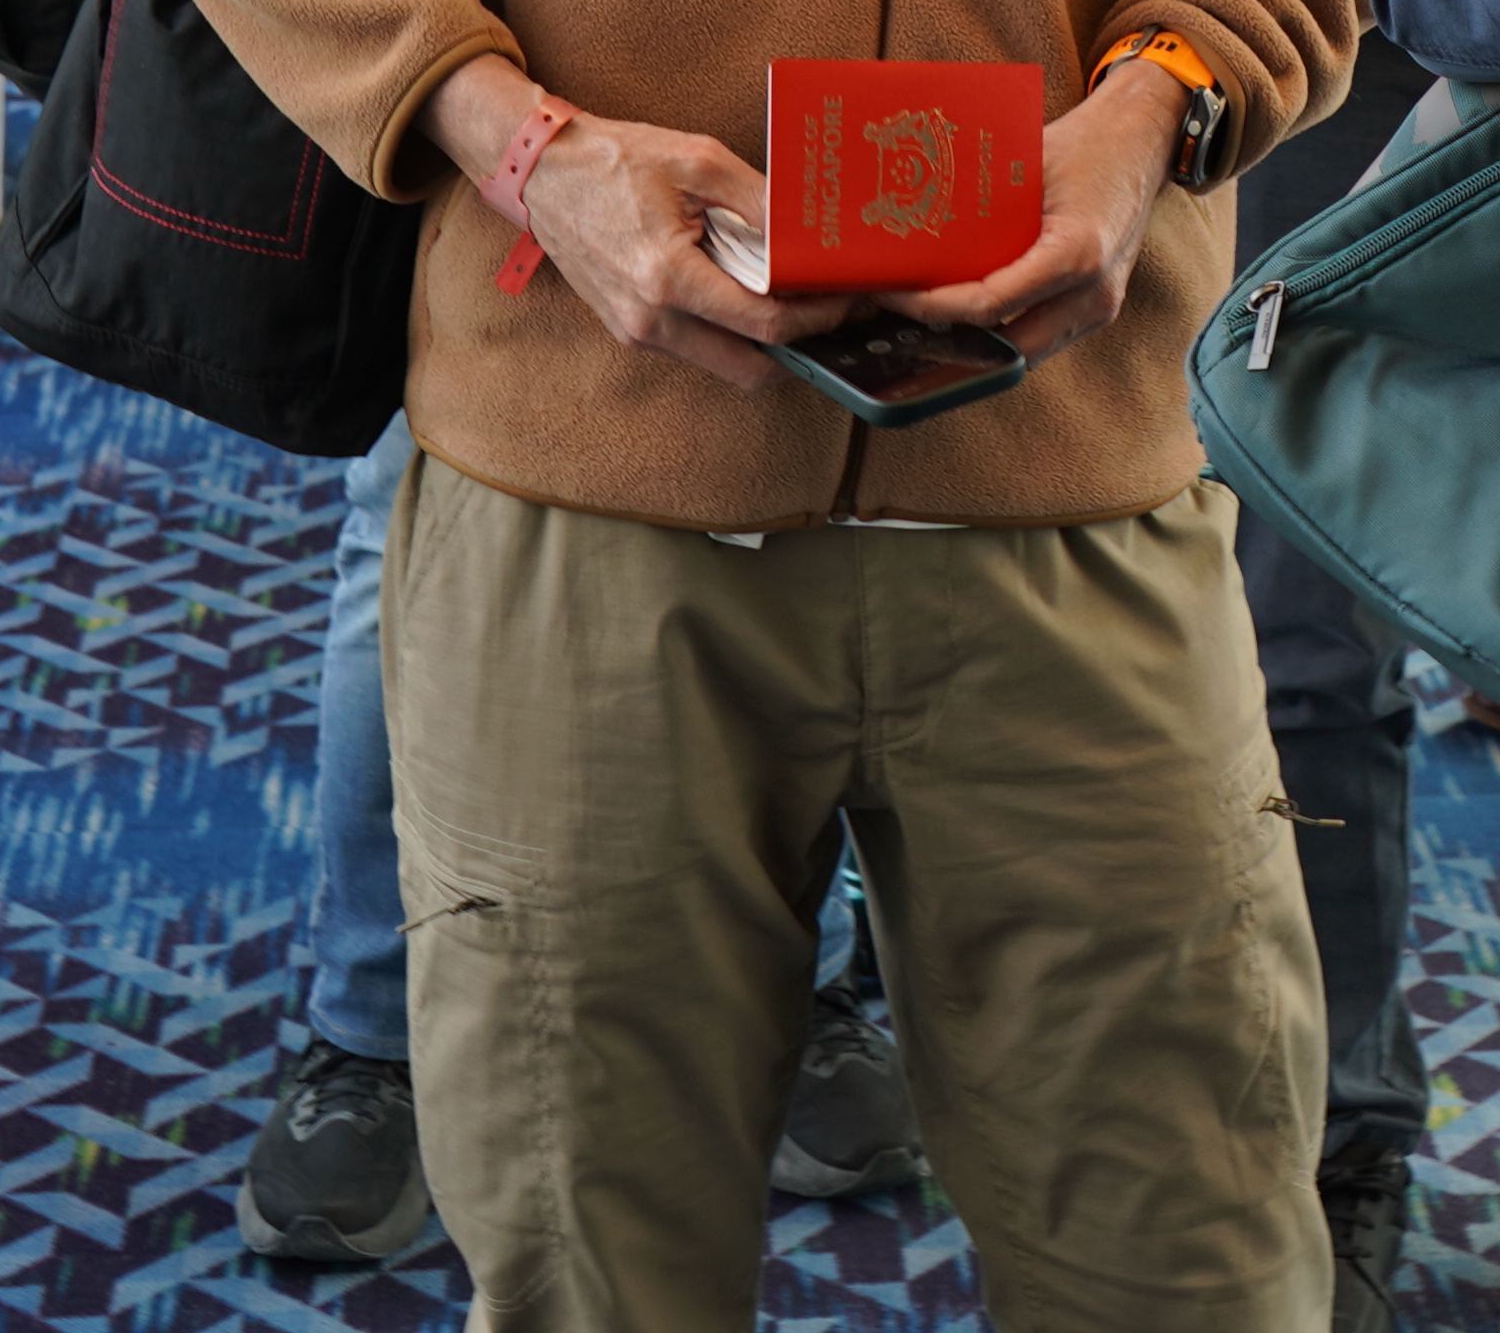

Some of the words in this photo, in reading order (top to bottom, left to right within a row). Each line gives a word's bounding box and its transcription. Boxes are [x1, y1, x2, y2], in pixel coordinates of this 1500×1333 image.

[803, 114, 818, 141] OF
[820, 94, 843, 249] SINGAPORE
[803, 143, 818, 228] REPUBLIC
[978, 127, 993, 218] PASSPORT
